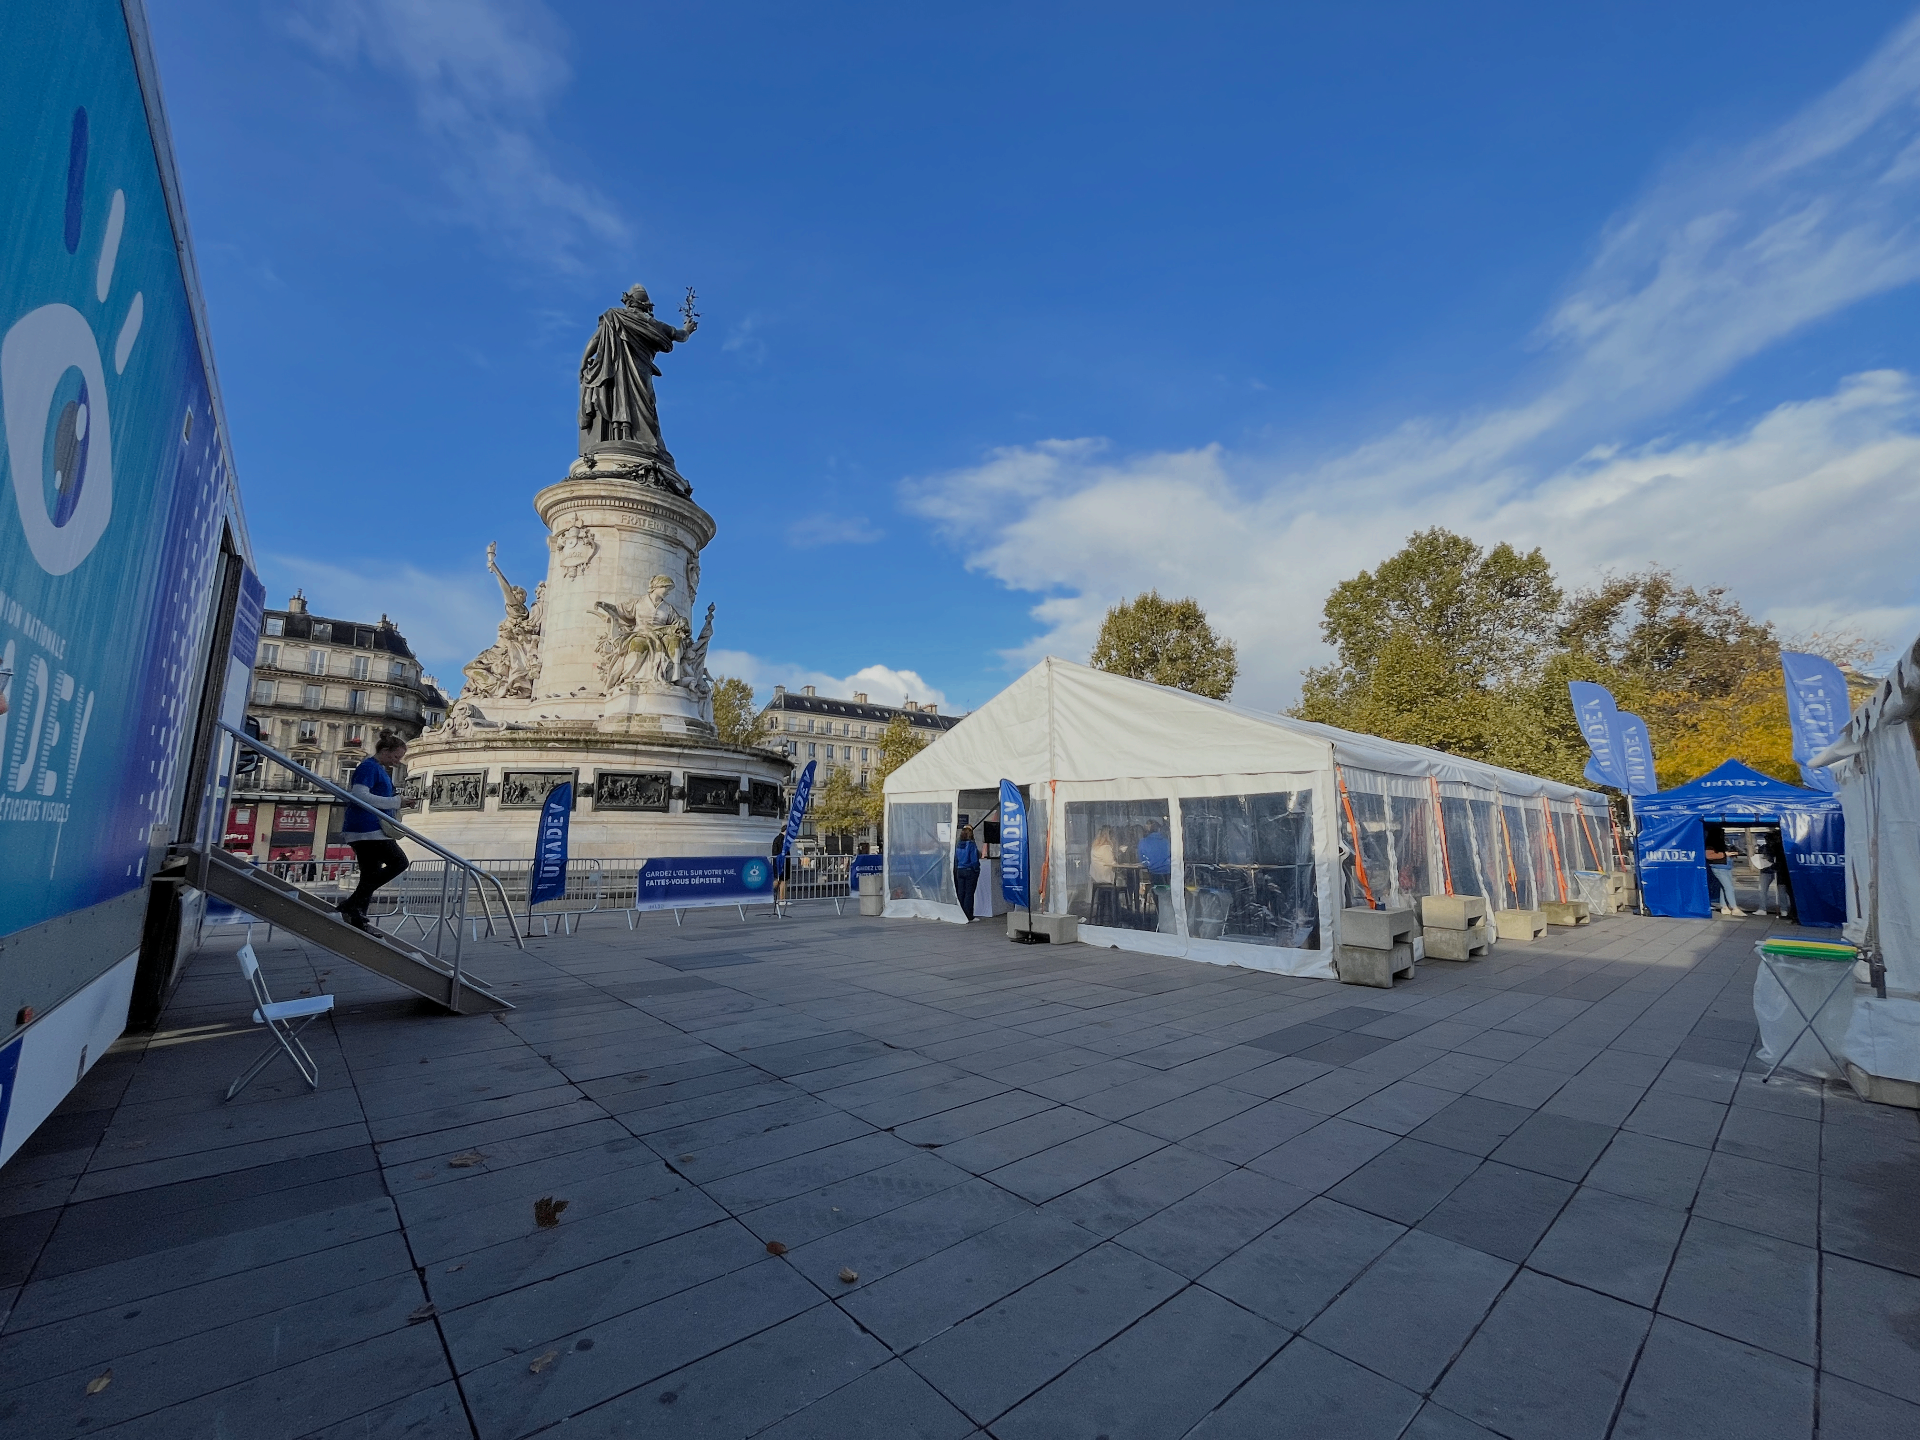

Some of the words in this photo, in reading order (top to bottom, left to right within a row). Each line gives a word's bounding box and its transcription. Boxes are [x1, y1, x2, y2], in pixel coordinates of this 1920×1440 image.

[1701, 780, 1769, 788] UNADEV
[542, 803, 565, 878] UNADEV
[1002, 801, 1021, 880] UNADEV
[1645, 850, 1696, 860] UNADEV
[645, 878, 690, 887] FAITES-VOUS
[691, 875, 722, 885] DÉPISTER
